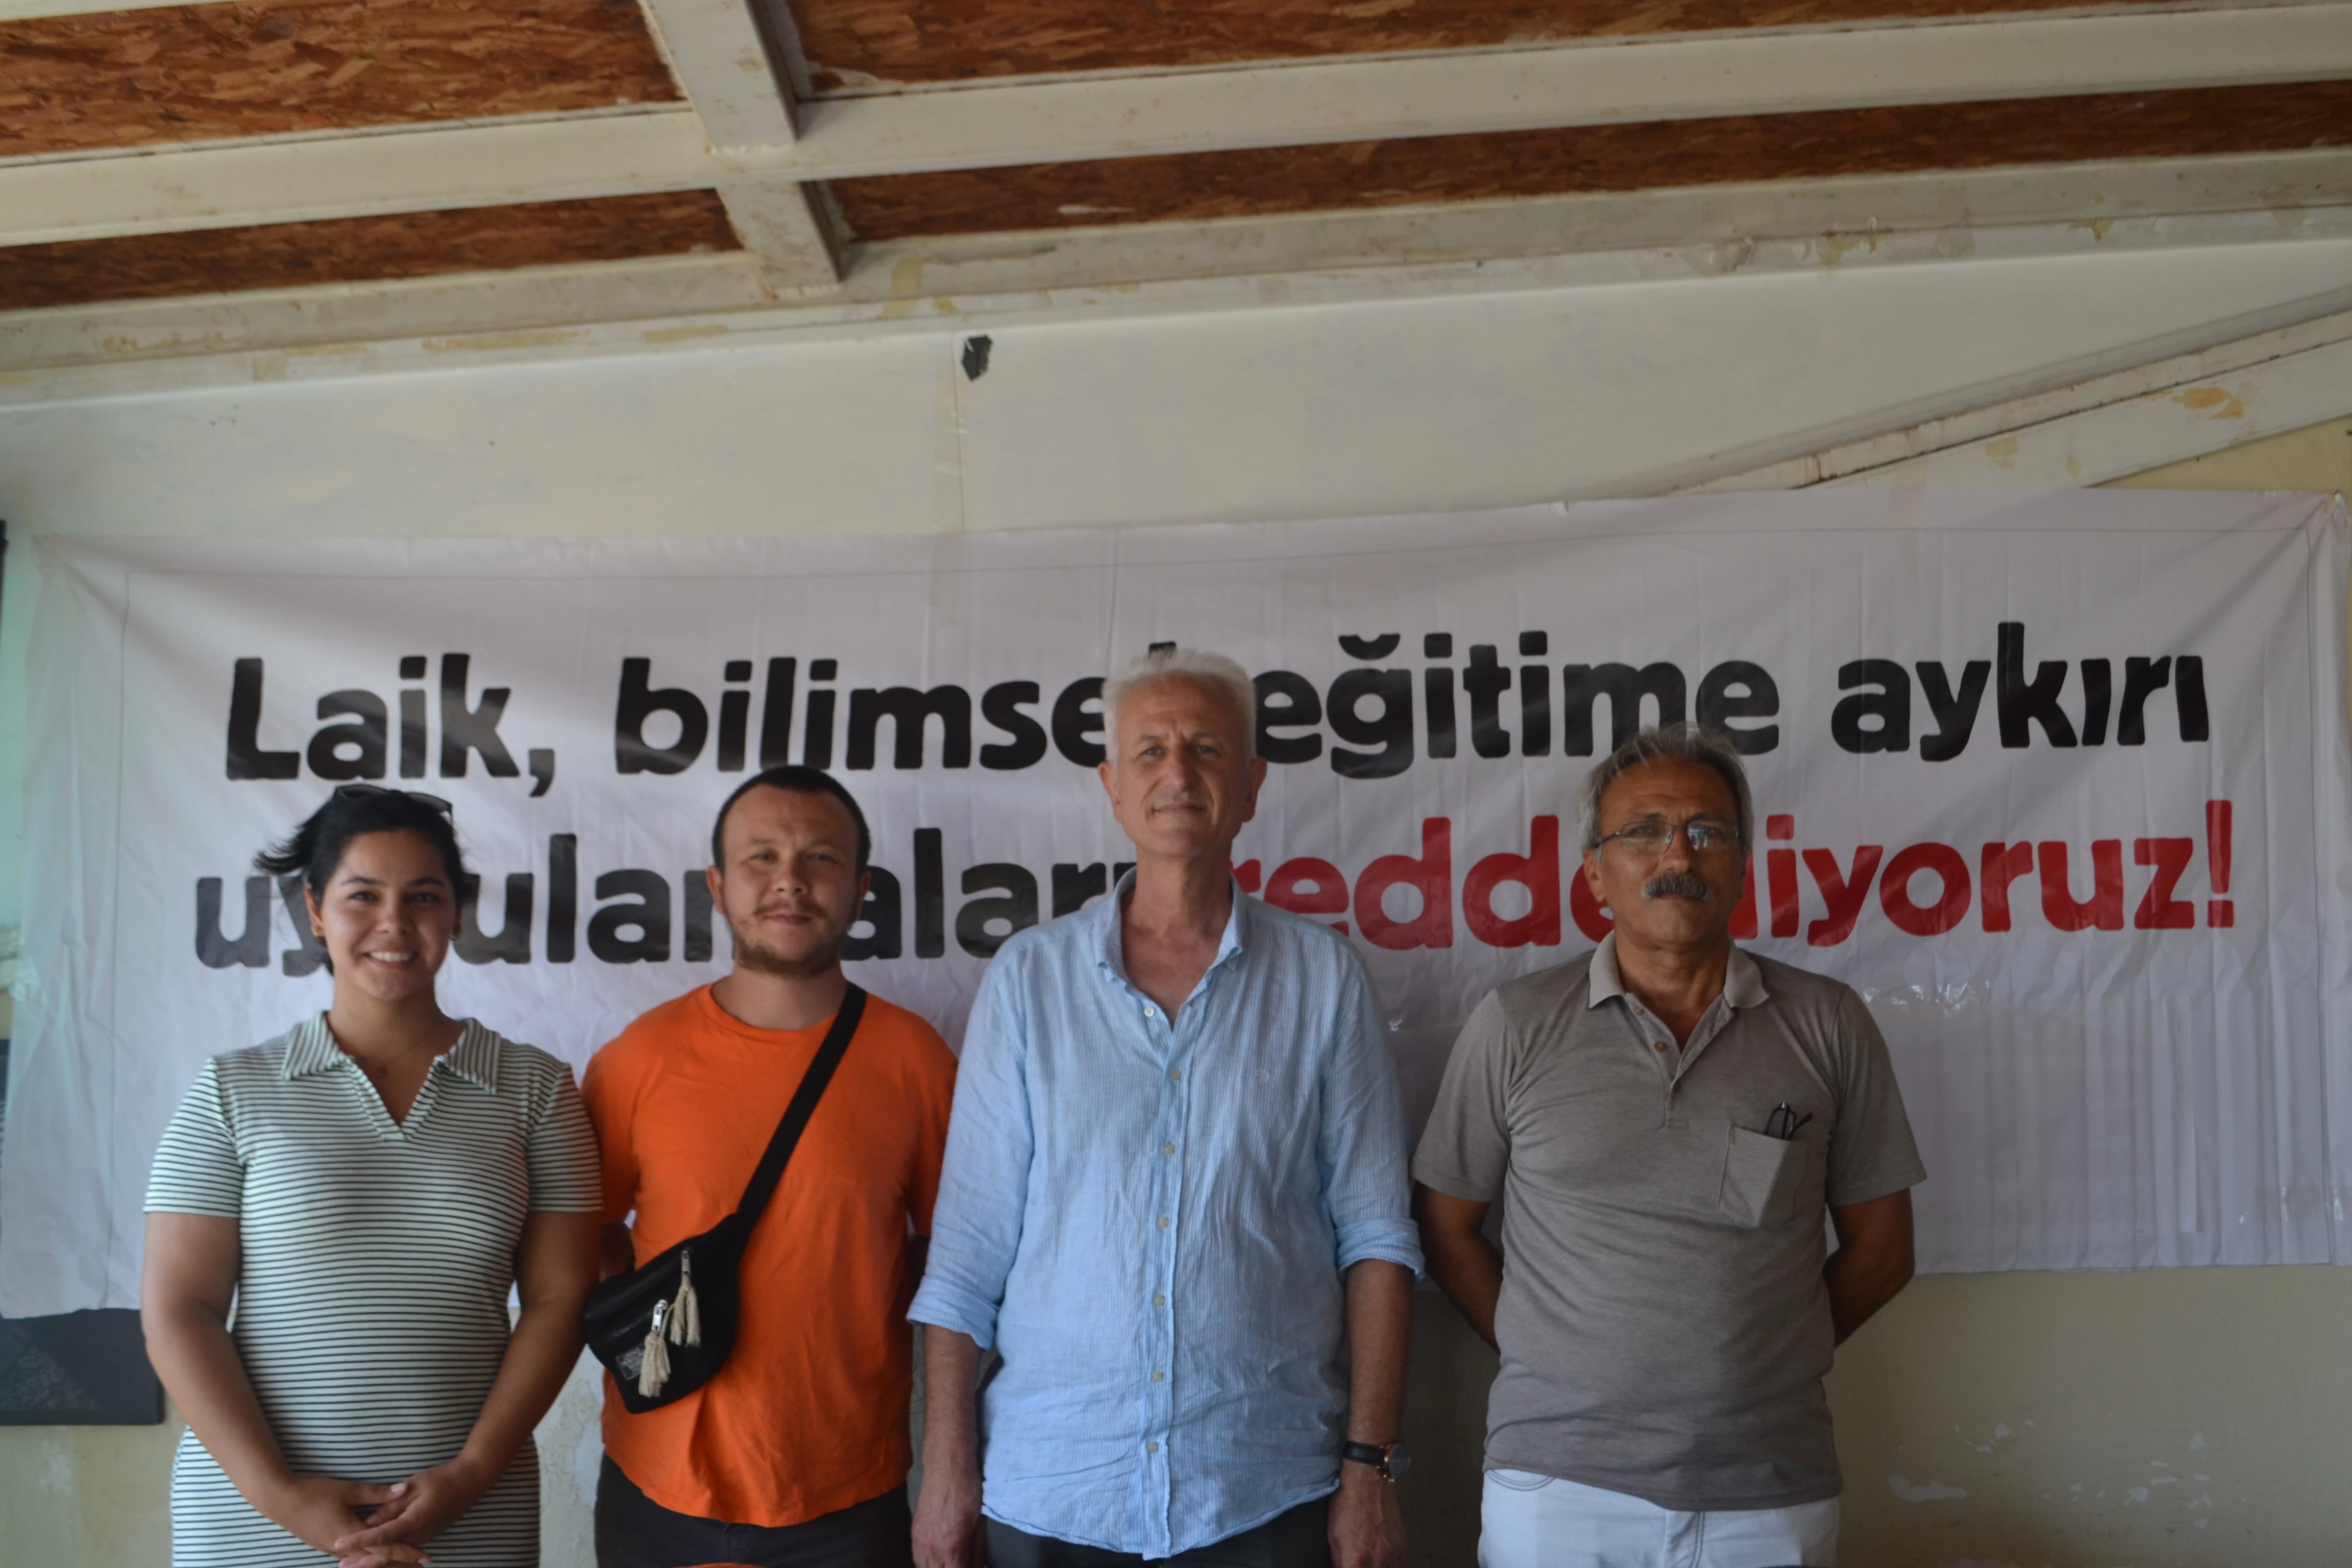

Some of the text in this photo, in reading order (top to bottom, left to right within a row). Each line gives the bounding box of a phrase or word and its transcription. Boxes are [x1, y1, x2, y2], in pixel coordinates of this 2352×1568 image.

[226, 622, 2209, 797] Laik, bilimse eğitime aykırı
[195, 800, 2235, 976] uyulaalar eddiyoruz!
